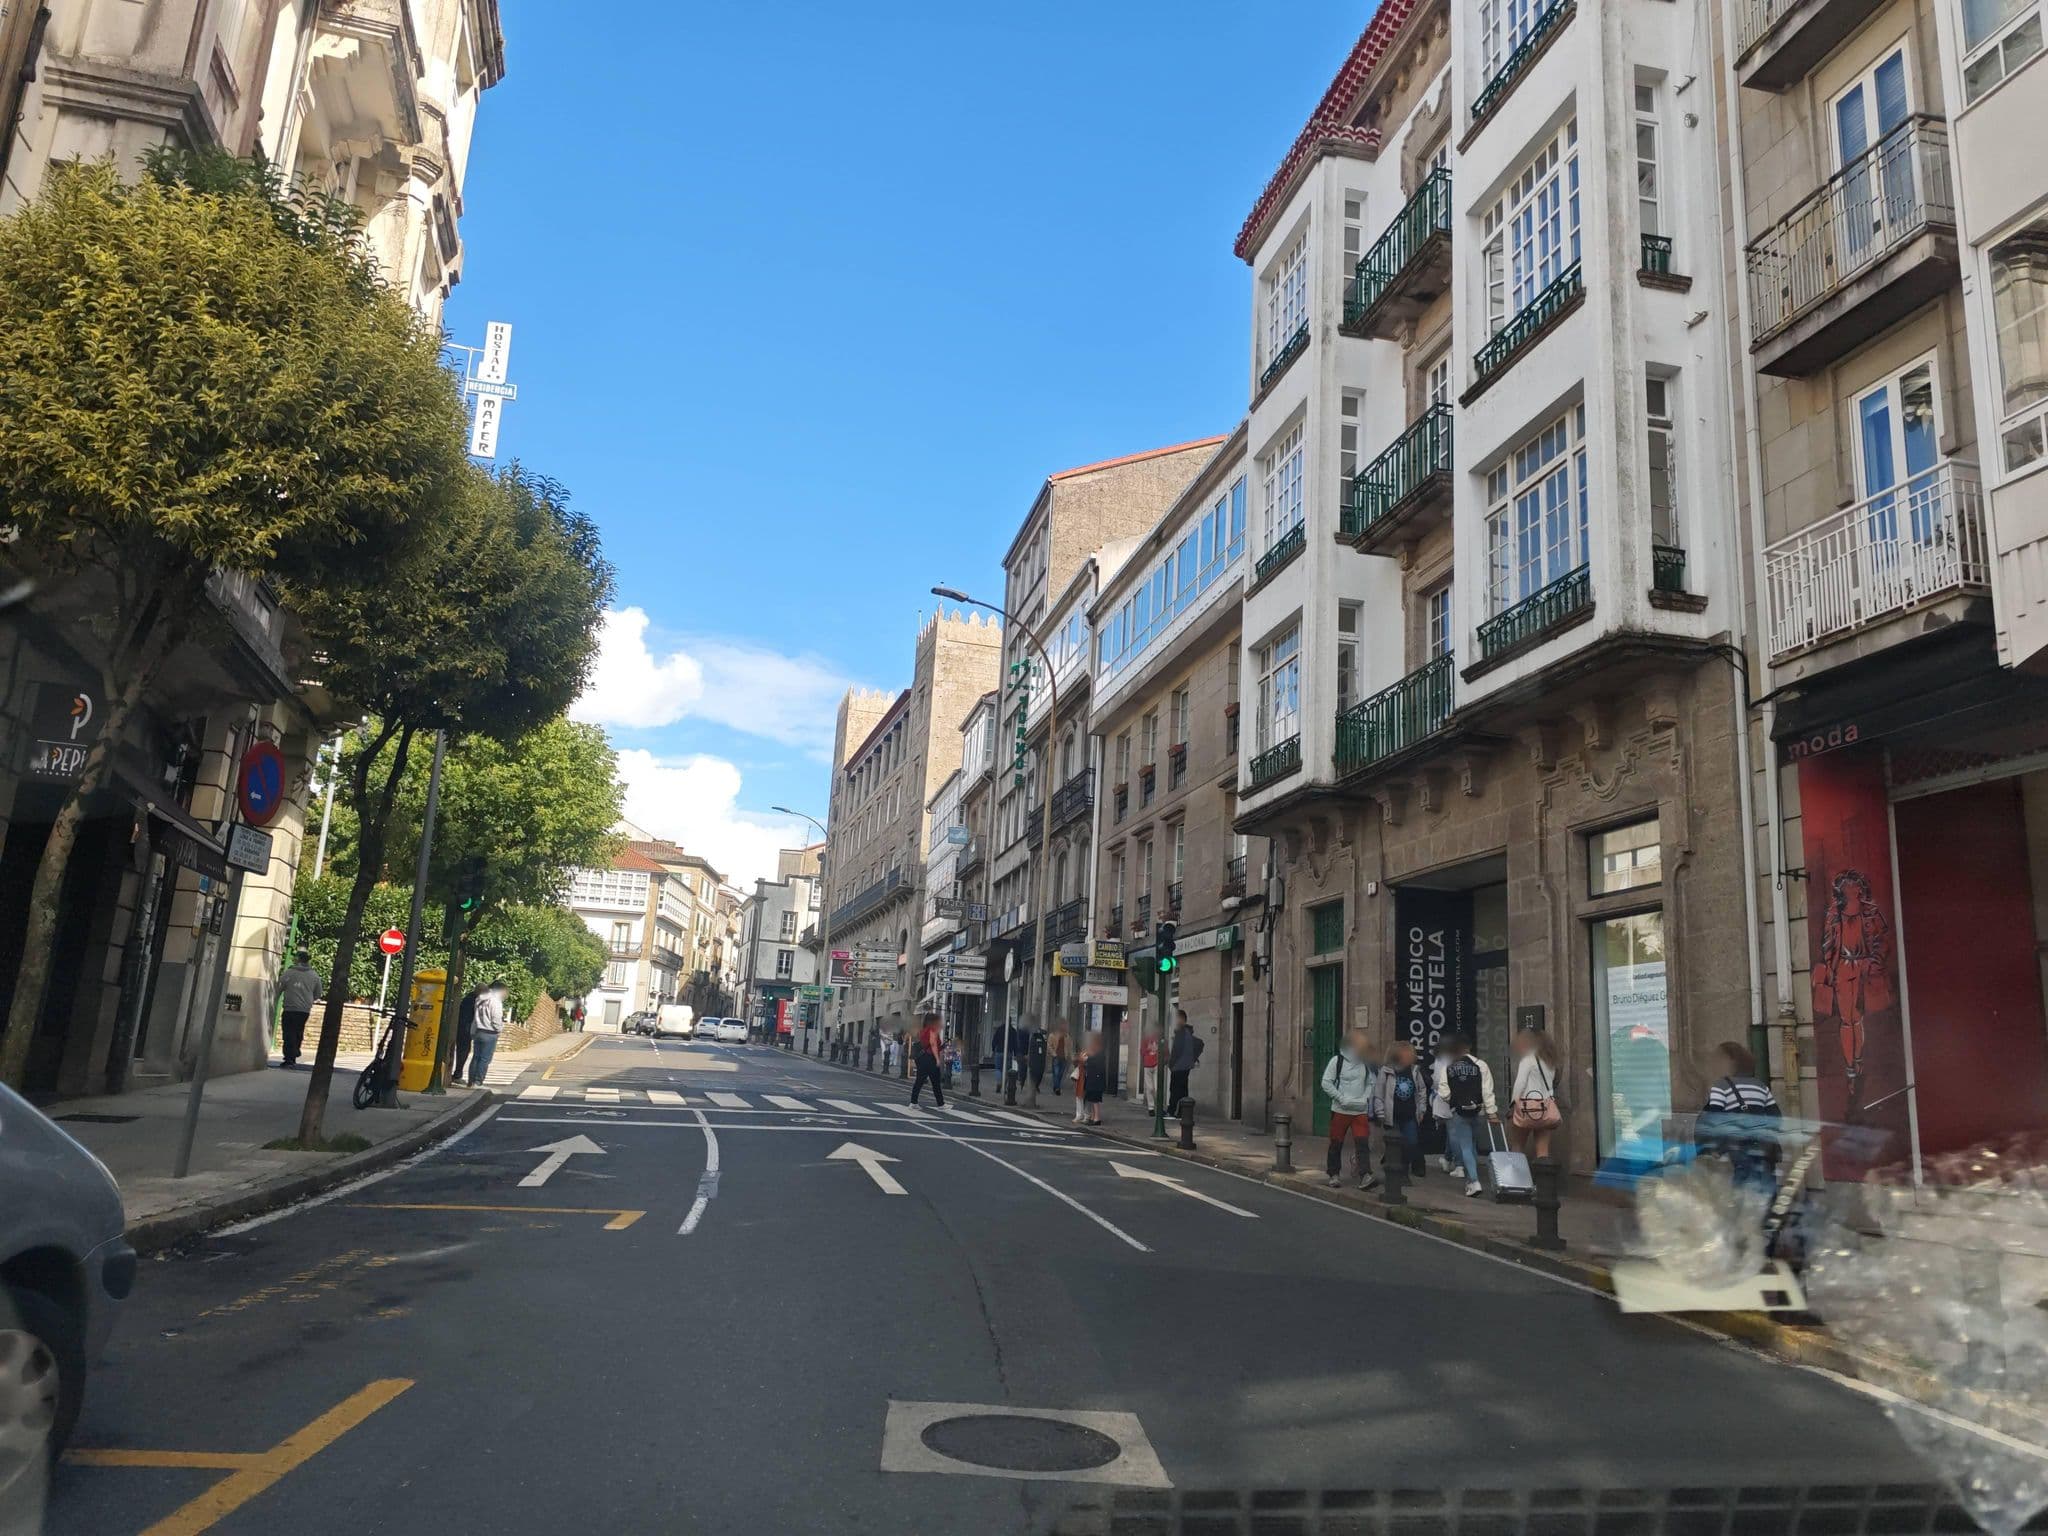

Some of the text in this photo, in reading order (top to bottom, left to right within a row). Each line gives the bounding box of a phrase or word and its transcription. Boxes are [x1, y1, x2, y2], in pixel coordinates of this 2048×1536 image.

[491, 325, 505, 374] HOSTAL
[478, 399, 496, 454] MAFER
[1788, 723, 1858, 760] moda
[1217, 931, 1230, 946] PSN
[1406, 926, 1424, 1013] MÉDICO
[1427, 929, 1445, 1050] POSTELA
